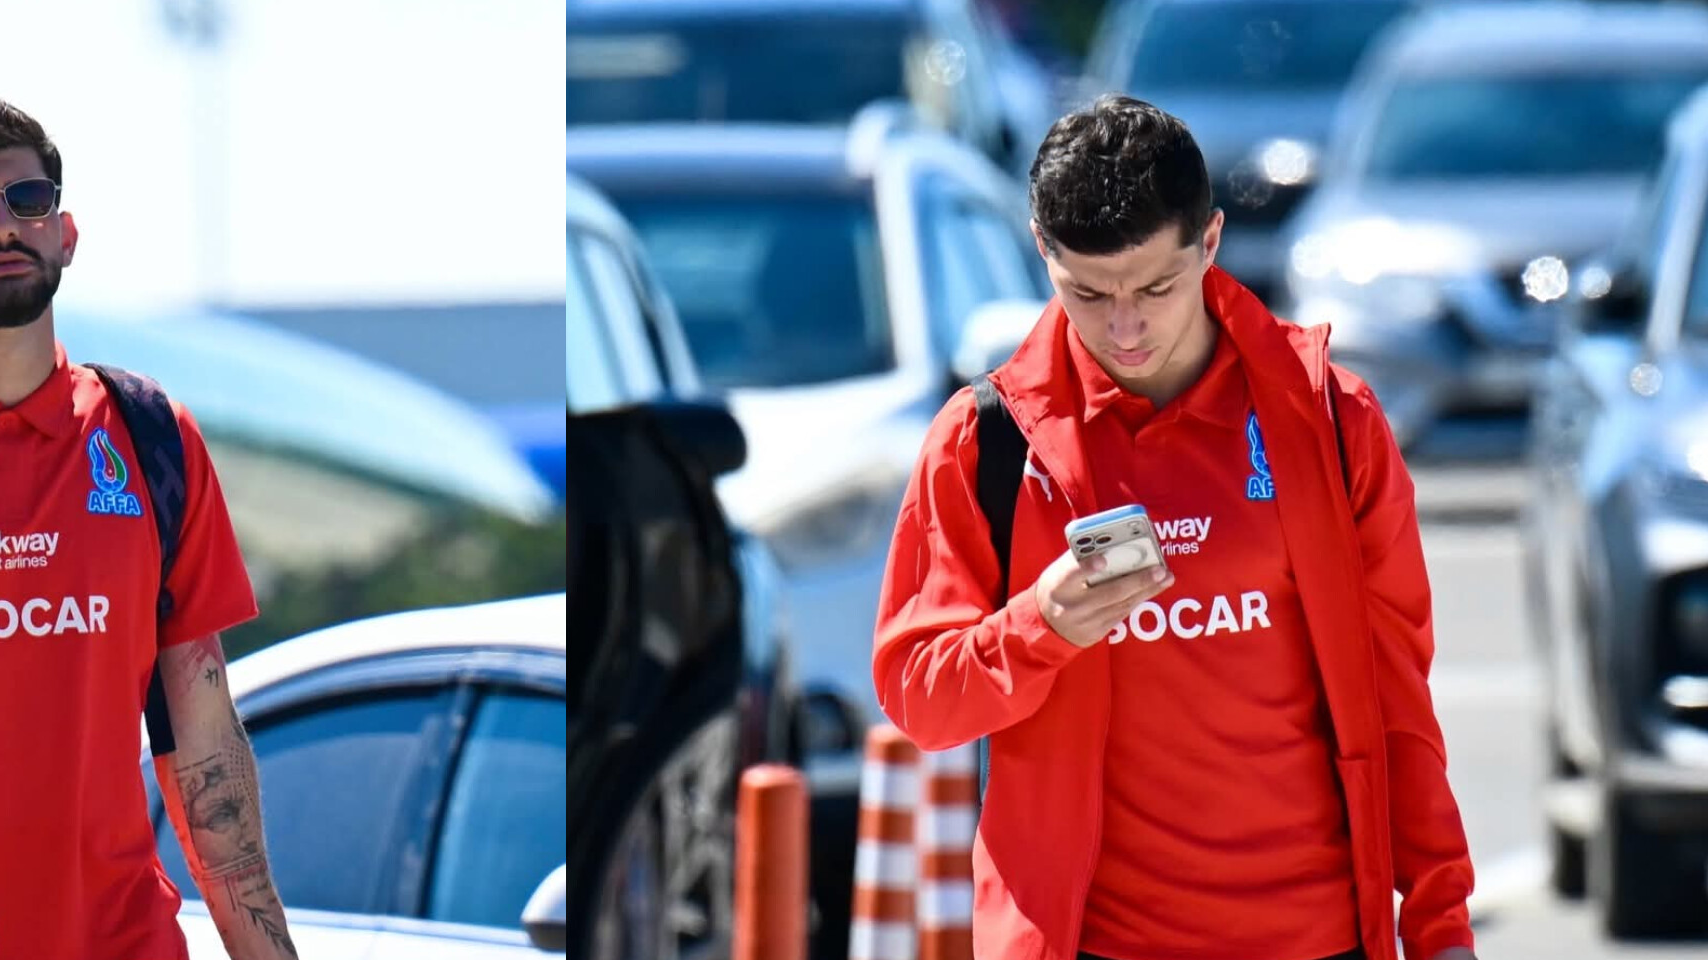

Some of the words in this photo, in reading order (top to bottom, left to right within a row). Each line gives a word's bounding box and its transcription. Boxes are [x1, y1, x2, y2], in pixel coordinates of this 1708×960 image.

[1247, 475, 1275, 499] AF
[88, 490, 142, 516] AFFA
[1161, 541, 1200, 556] rlines
[4, 554, 48, 569] airlines
